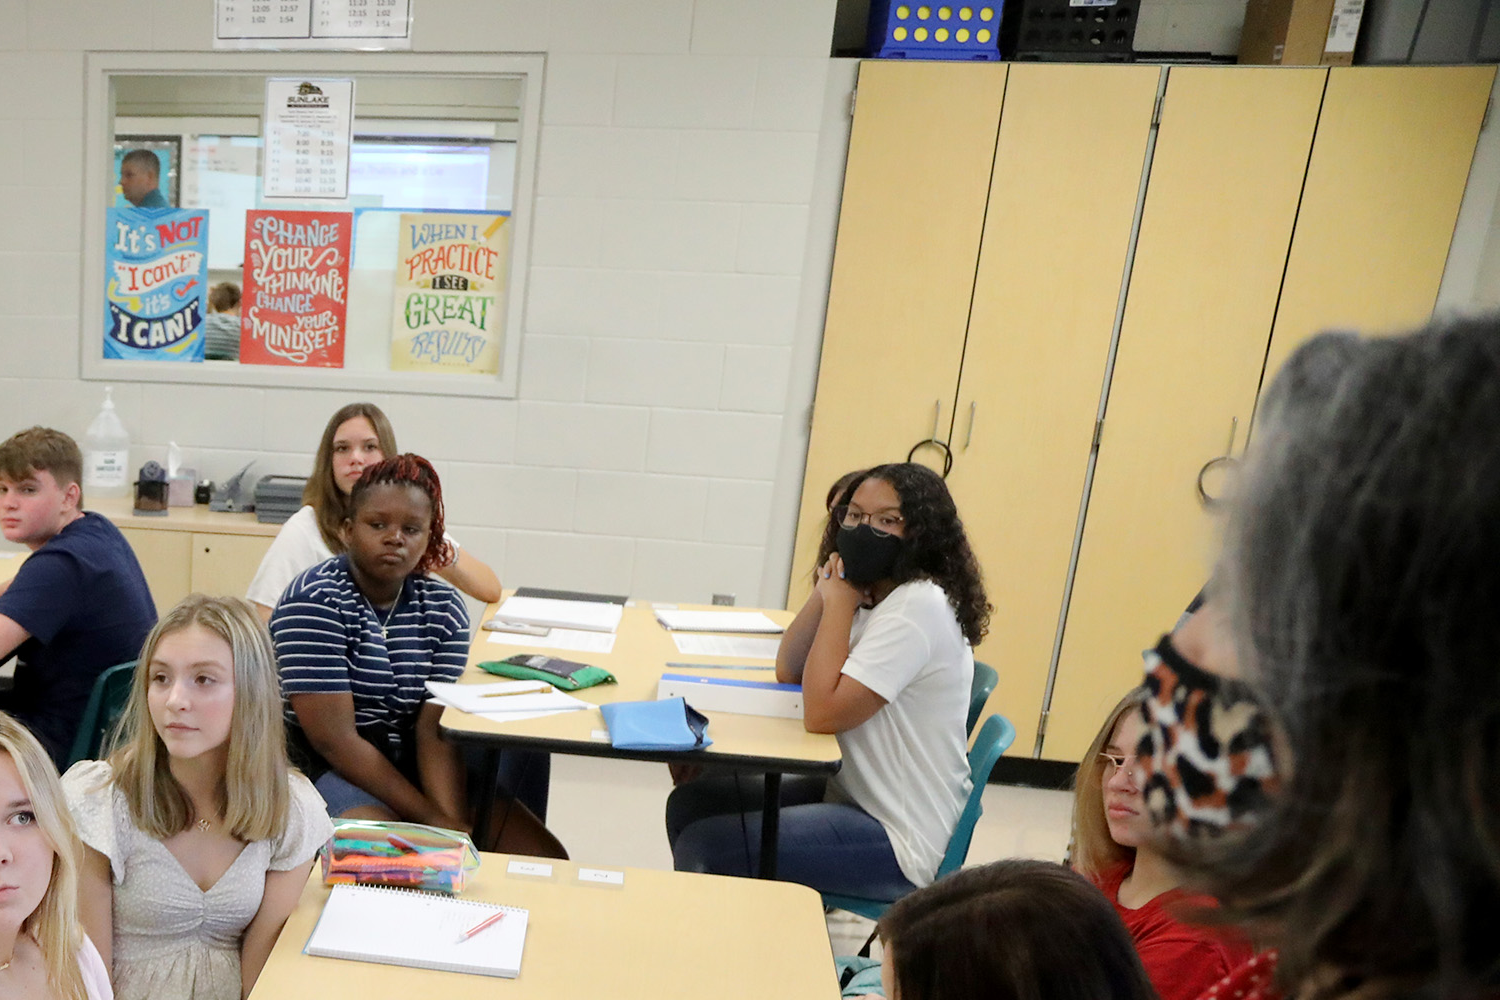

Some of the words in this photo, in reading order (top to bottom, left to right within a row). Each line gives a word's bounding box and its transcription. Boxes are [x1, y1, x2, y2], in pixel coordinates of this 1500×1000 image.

[114, 221, 157, 254] It's
[155, 216, 204, 249] NOT
[254, 216, 340, 247] CHANGE
[410, 223, 467, 249] WHEN
[471, 225, 478, 241] I
[250, 239, 339, 277] YOUR
[405, 243, 498, 281] PRACTICE
[434, 279, 440, 288] I
[444, 276, 465, 289] SEE
[145, 293, 171, 316] it's
[256, 290, 316, 313] CHANGE
[404, 292, 496, 331] GREAT
[293, 310, 338, 331] YOUR
